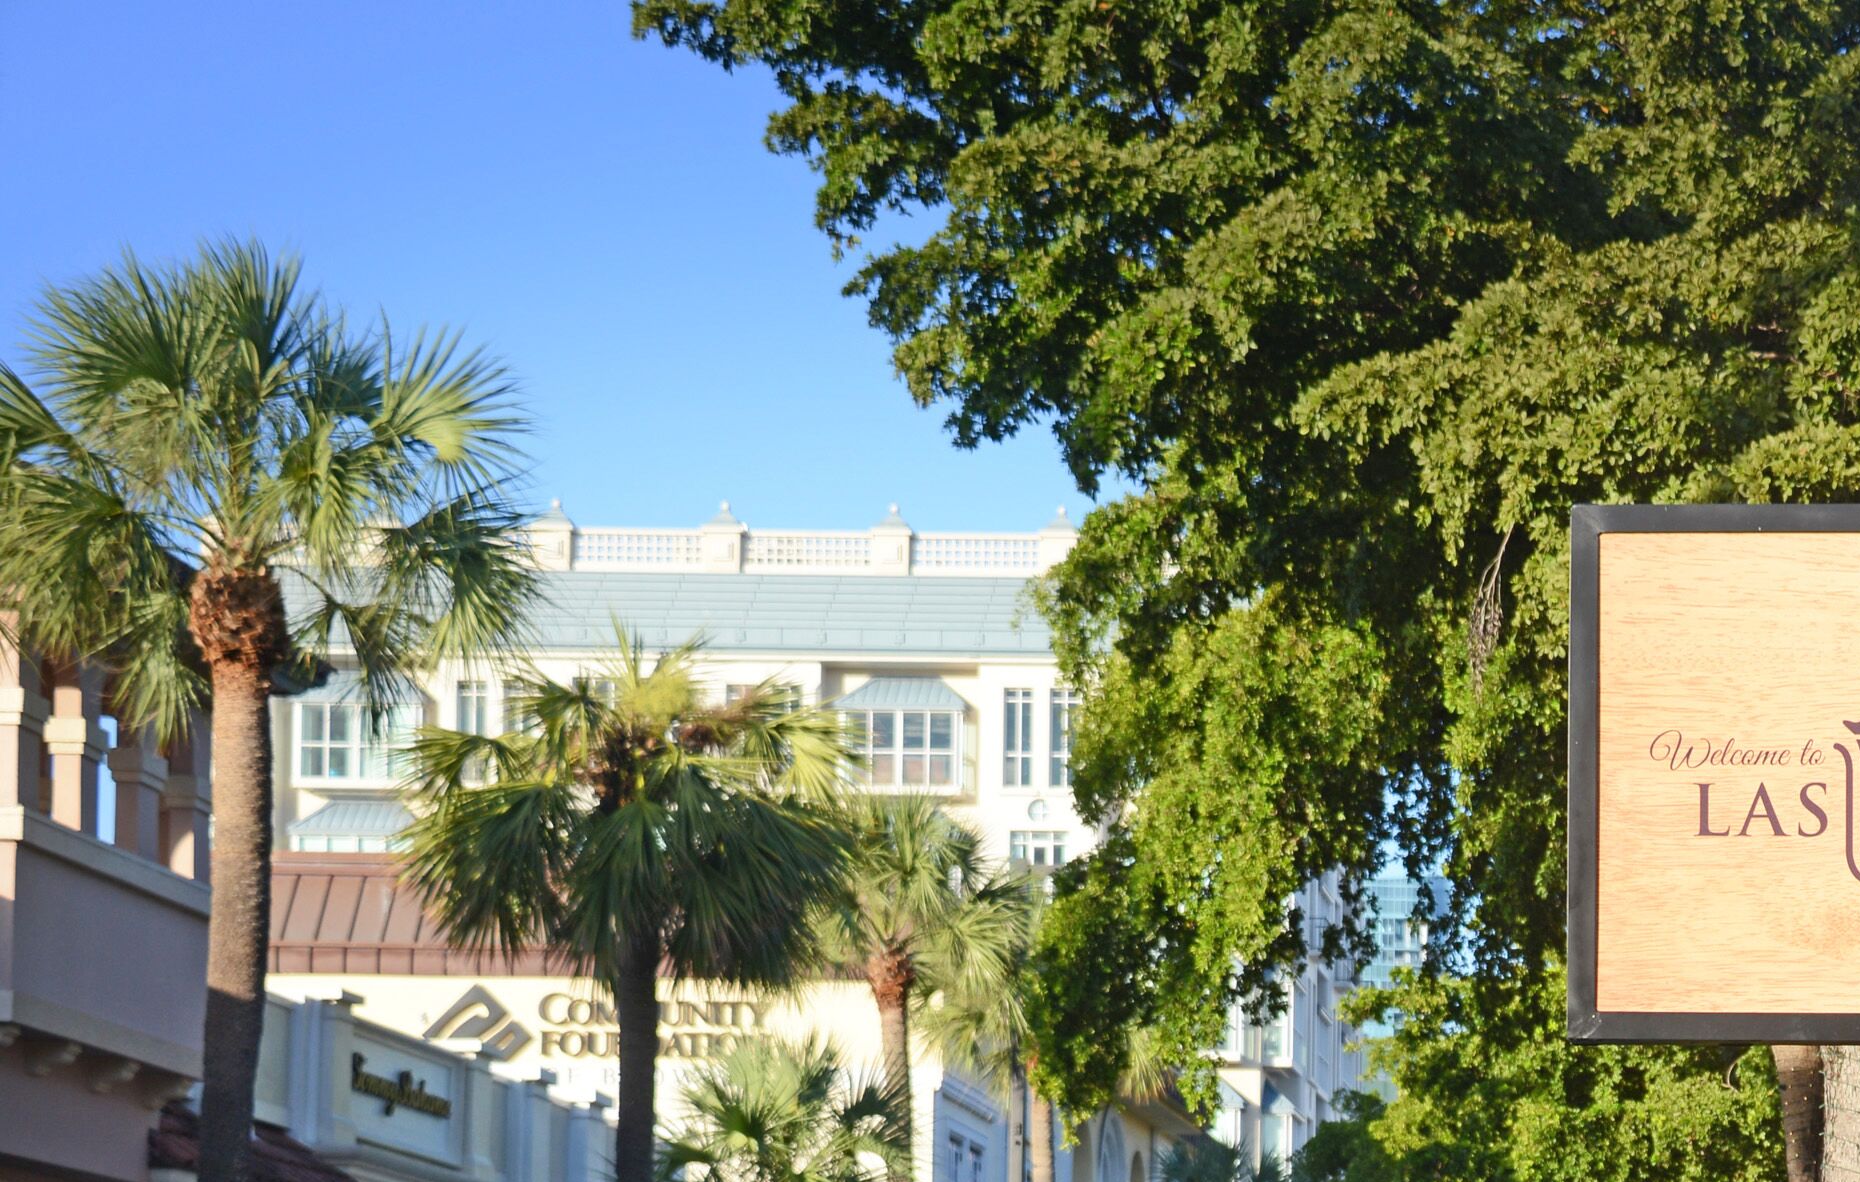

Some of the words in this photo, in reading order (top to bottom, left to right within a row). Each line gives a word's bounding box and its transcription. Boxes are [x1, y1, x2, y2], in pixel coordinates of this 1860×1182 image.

[1649, 729, 1791, 771] Welcome
[1800, 738, 1826, 766] to
[1693, 781, 1829, 838] LAS
[538, 992, 768, 1026] COMUNITY
